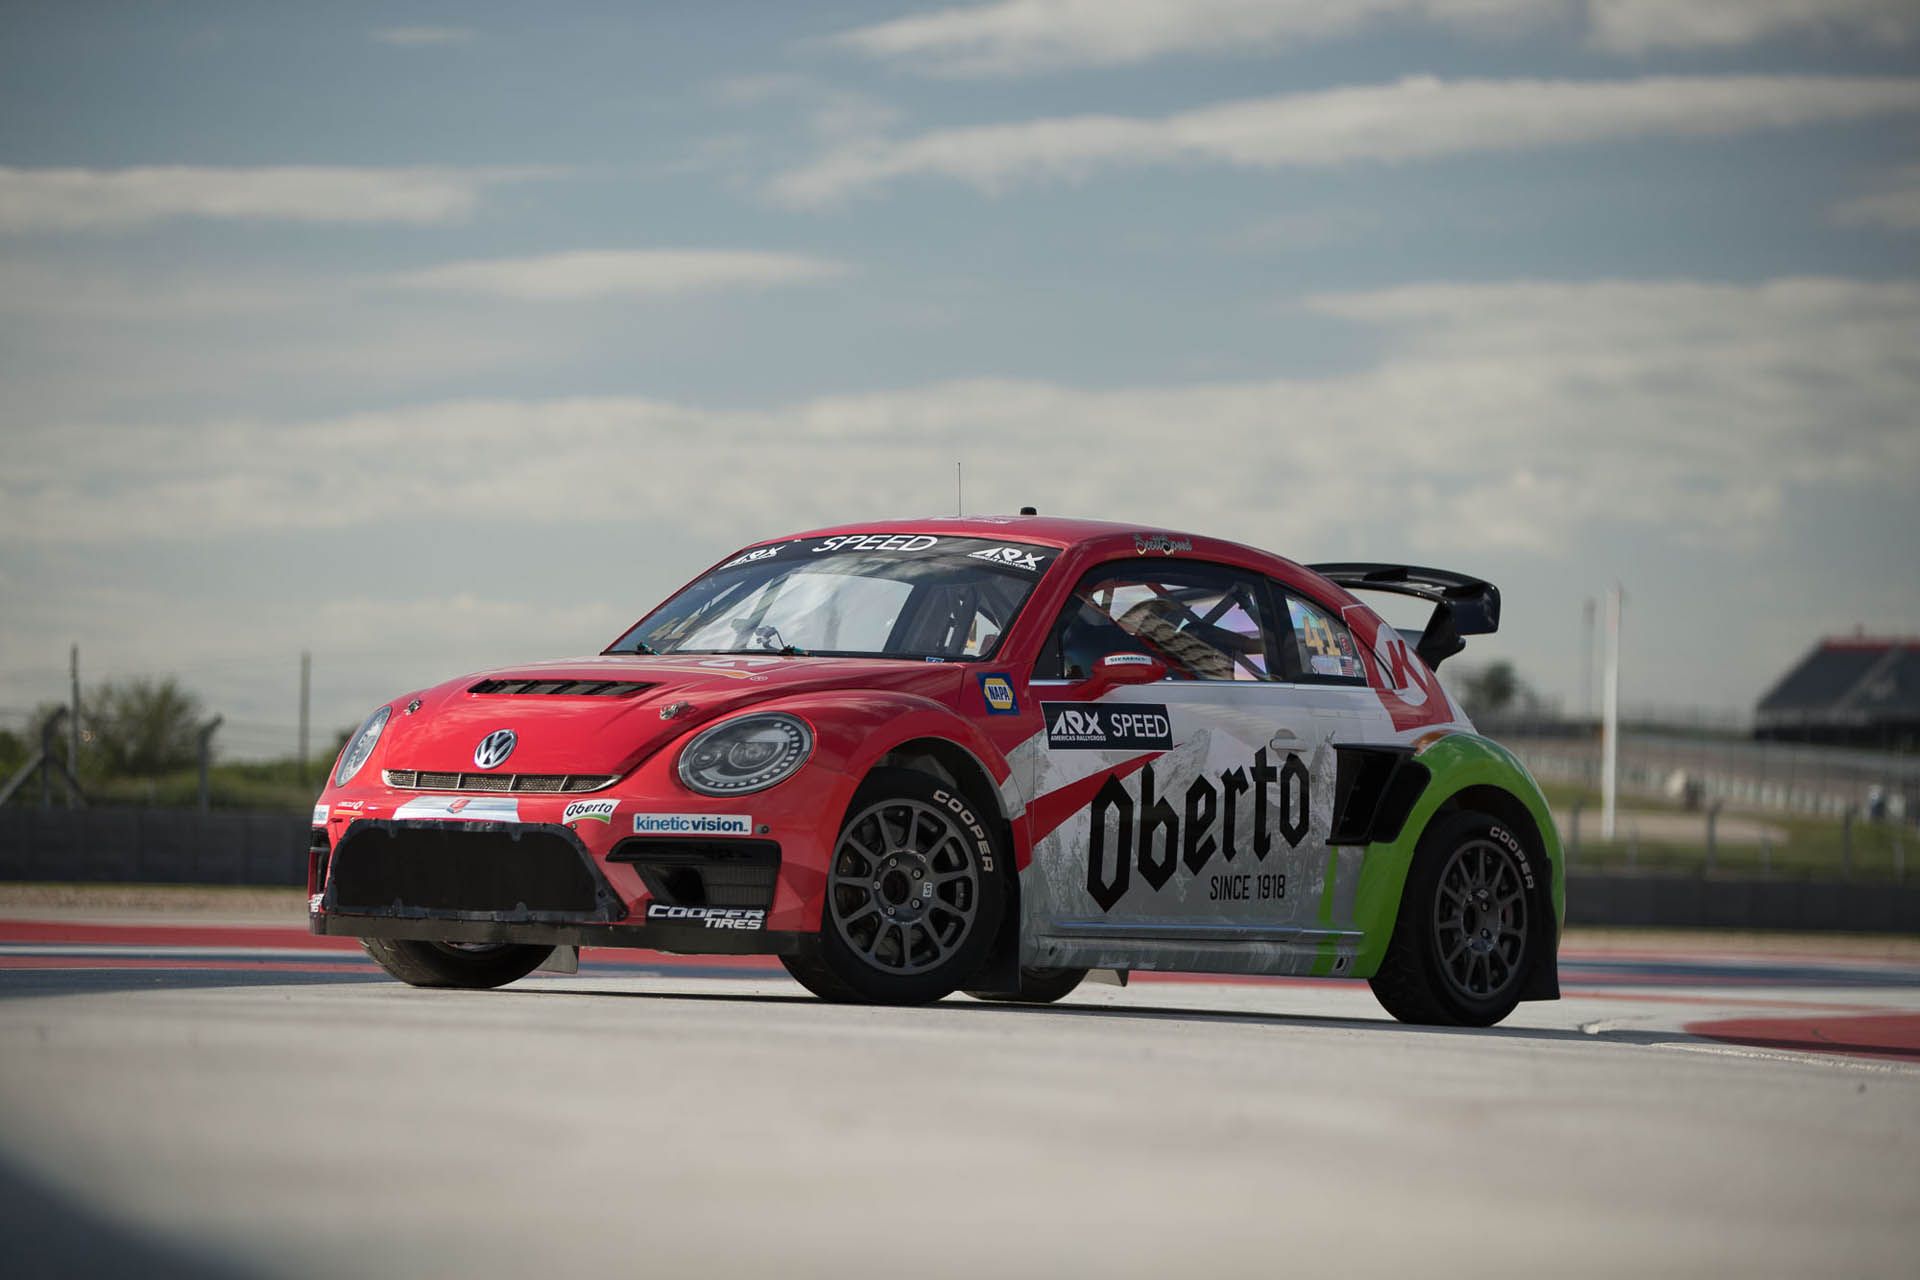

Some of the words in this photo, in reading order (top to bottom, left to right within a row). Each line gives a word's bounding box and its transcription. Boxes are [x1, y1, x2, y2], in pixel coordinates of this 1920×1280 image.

[812, 534, 938, 552] SPEED
[1302, 615, 1341, 656] 41
[988, 685, 1010, 701] NAPA
[1051, 710, 1104, 735] ARX
[1110, 713, 1169, 738] SPEED
[566, 802, 613, 816] Oberto
[932, 789, 995, 873] COOPER
[1087, 746, 1309, 913] Oberto
[1489, 826, 1534, 889] COOPER
[1210, 876, 1251, 900] SINCE
[1257, 874, 1286, 900] 1918
[648, 904, 765, 919] COOPER
[704, 918, 762, 930] TIRES
